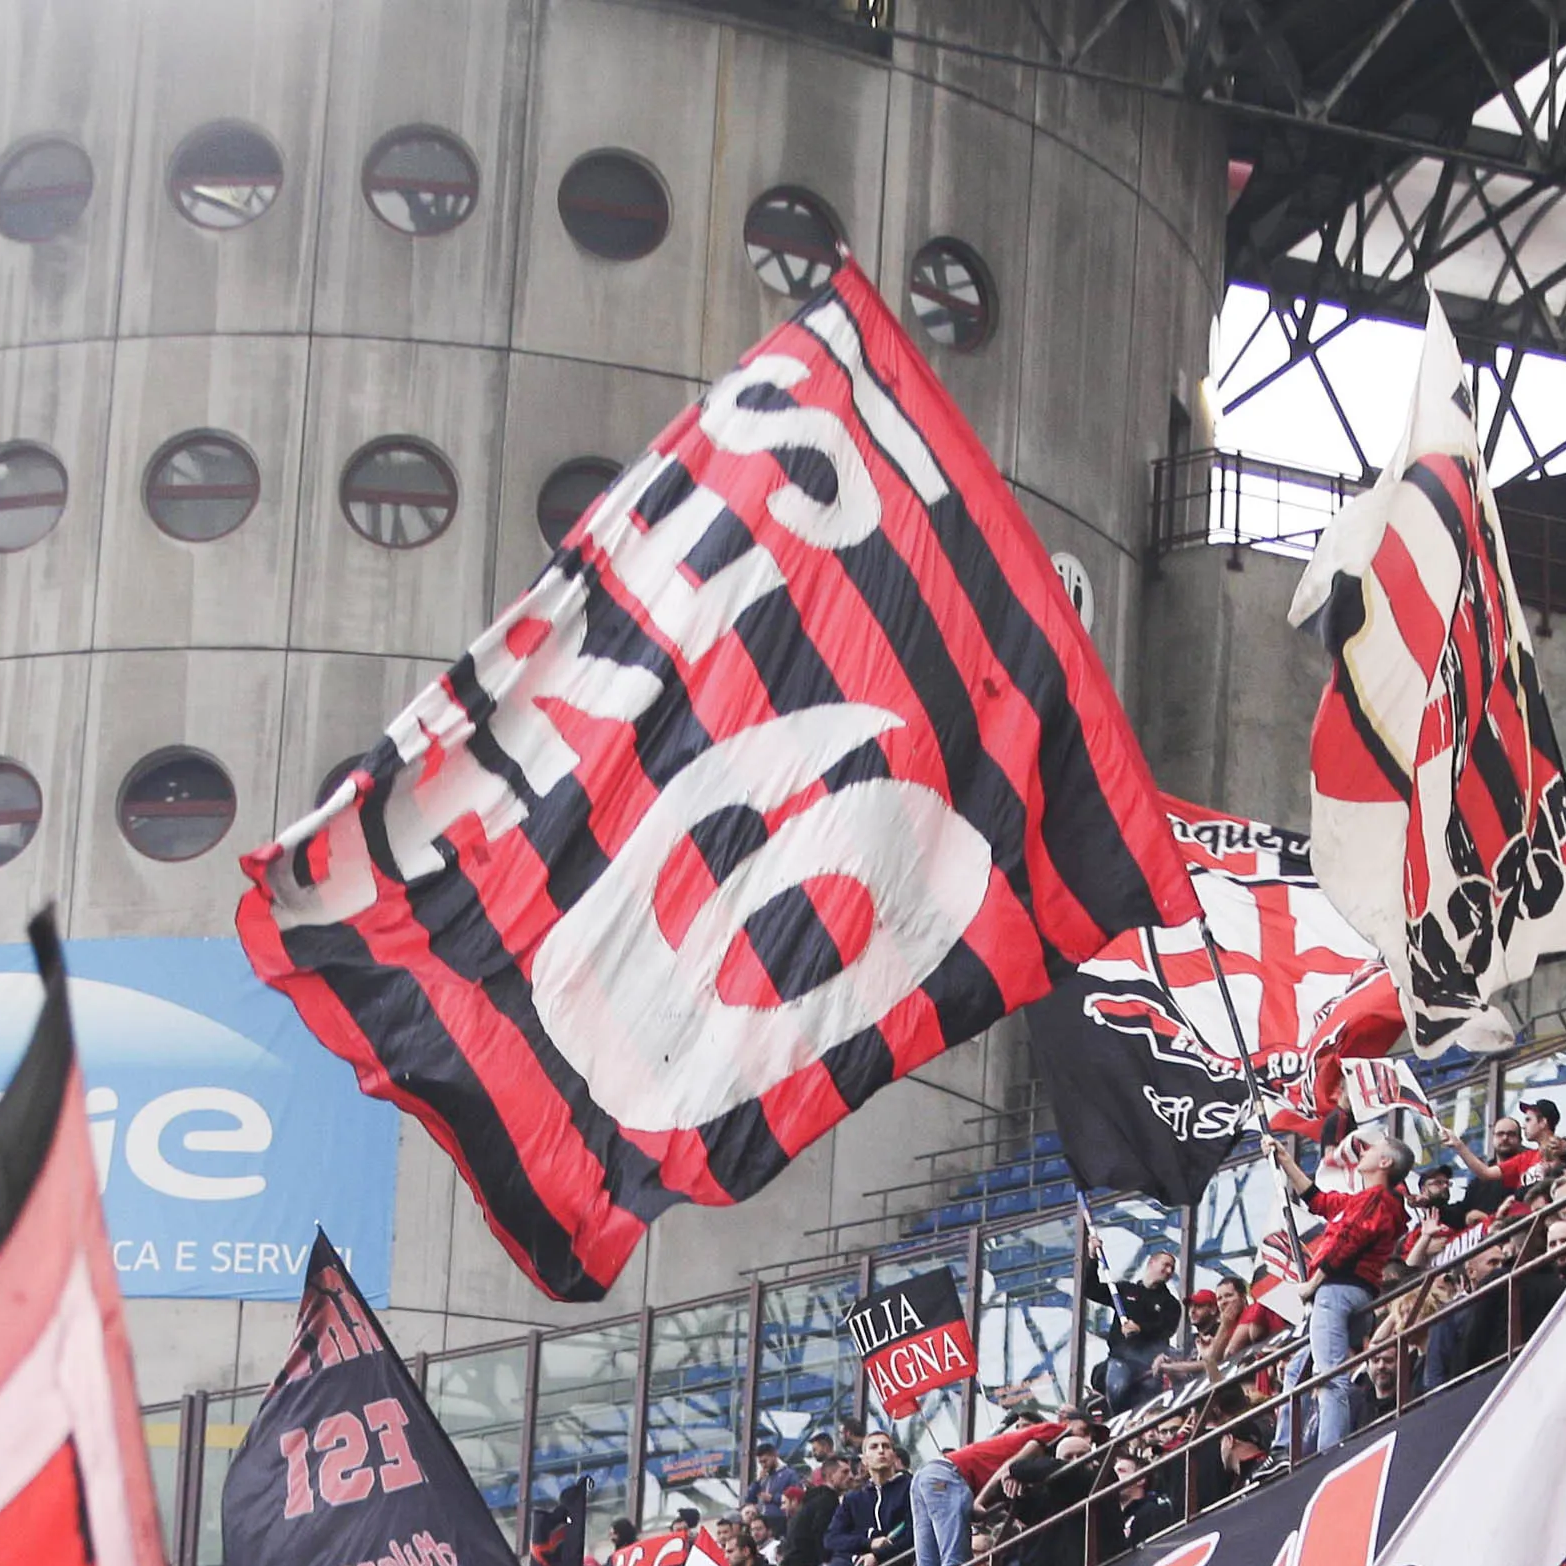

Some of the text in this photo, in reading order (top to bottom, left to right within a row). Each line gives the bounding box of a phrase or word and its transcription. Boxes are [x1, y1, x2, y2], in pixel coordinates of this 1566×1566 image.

[531, 702, 992, 1132] 6
[113, 1239, 161, 1272] CA
[175, 1241, 198, 1272] E
[867, 1330, 969, 1404] AGNA
